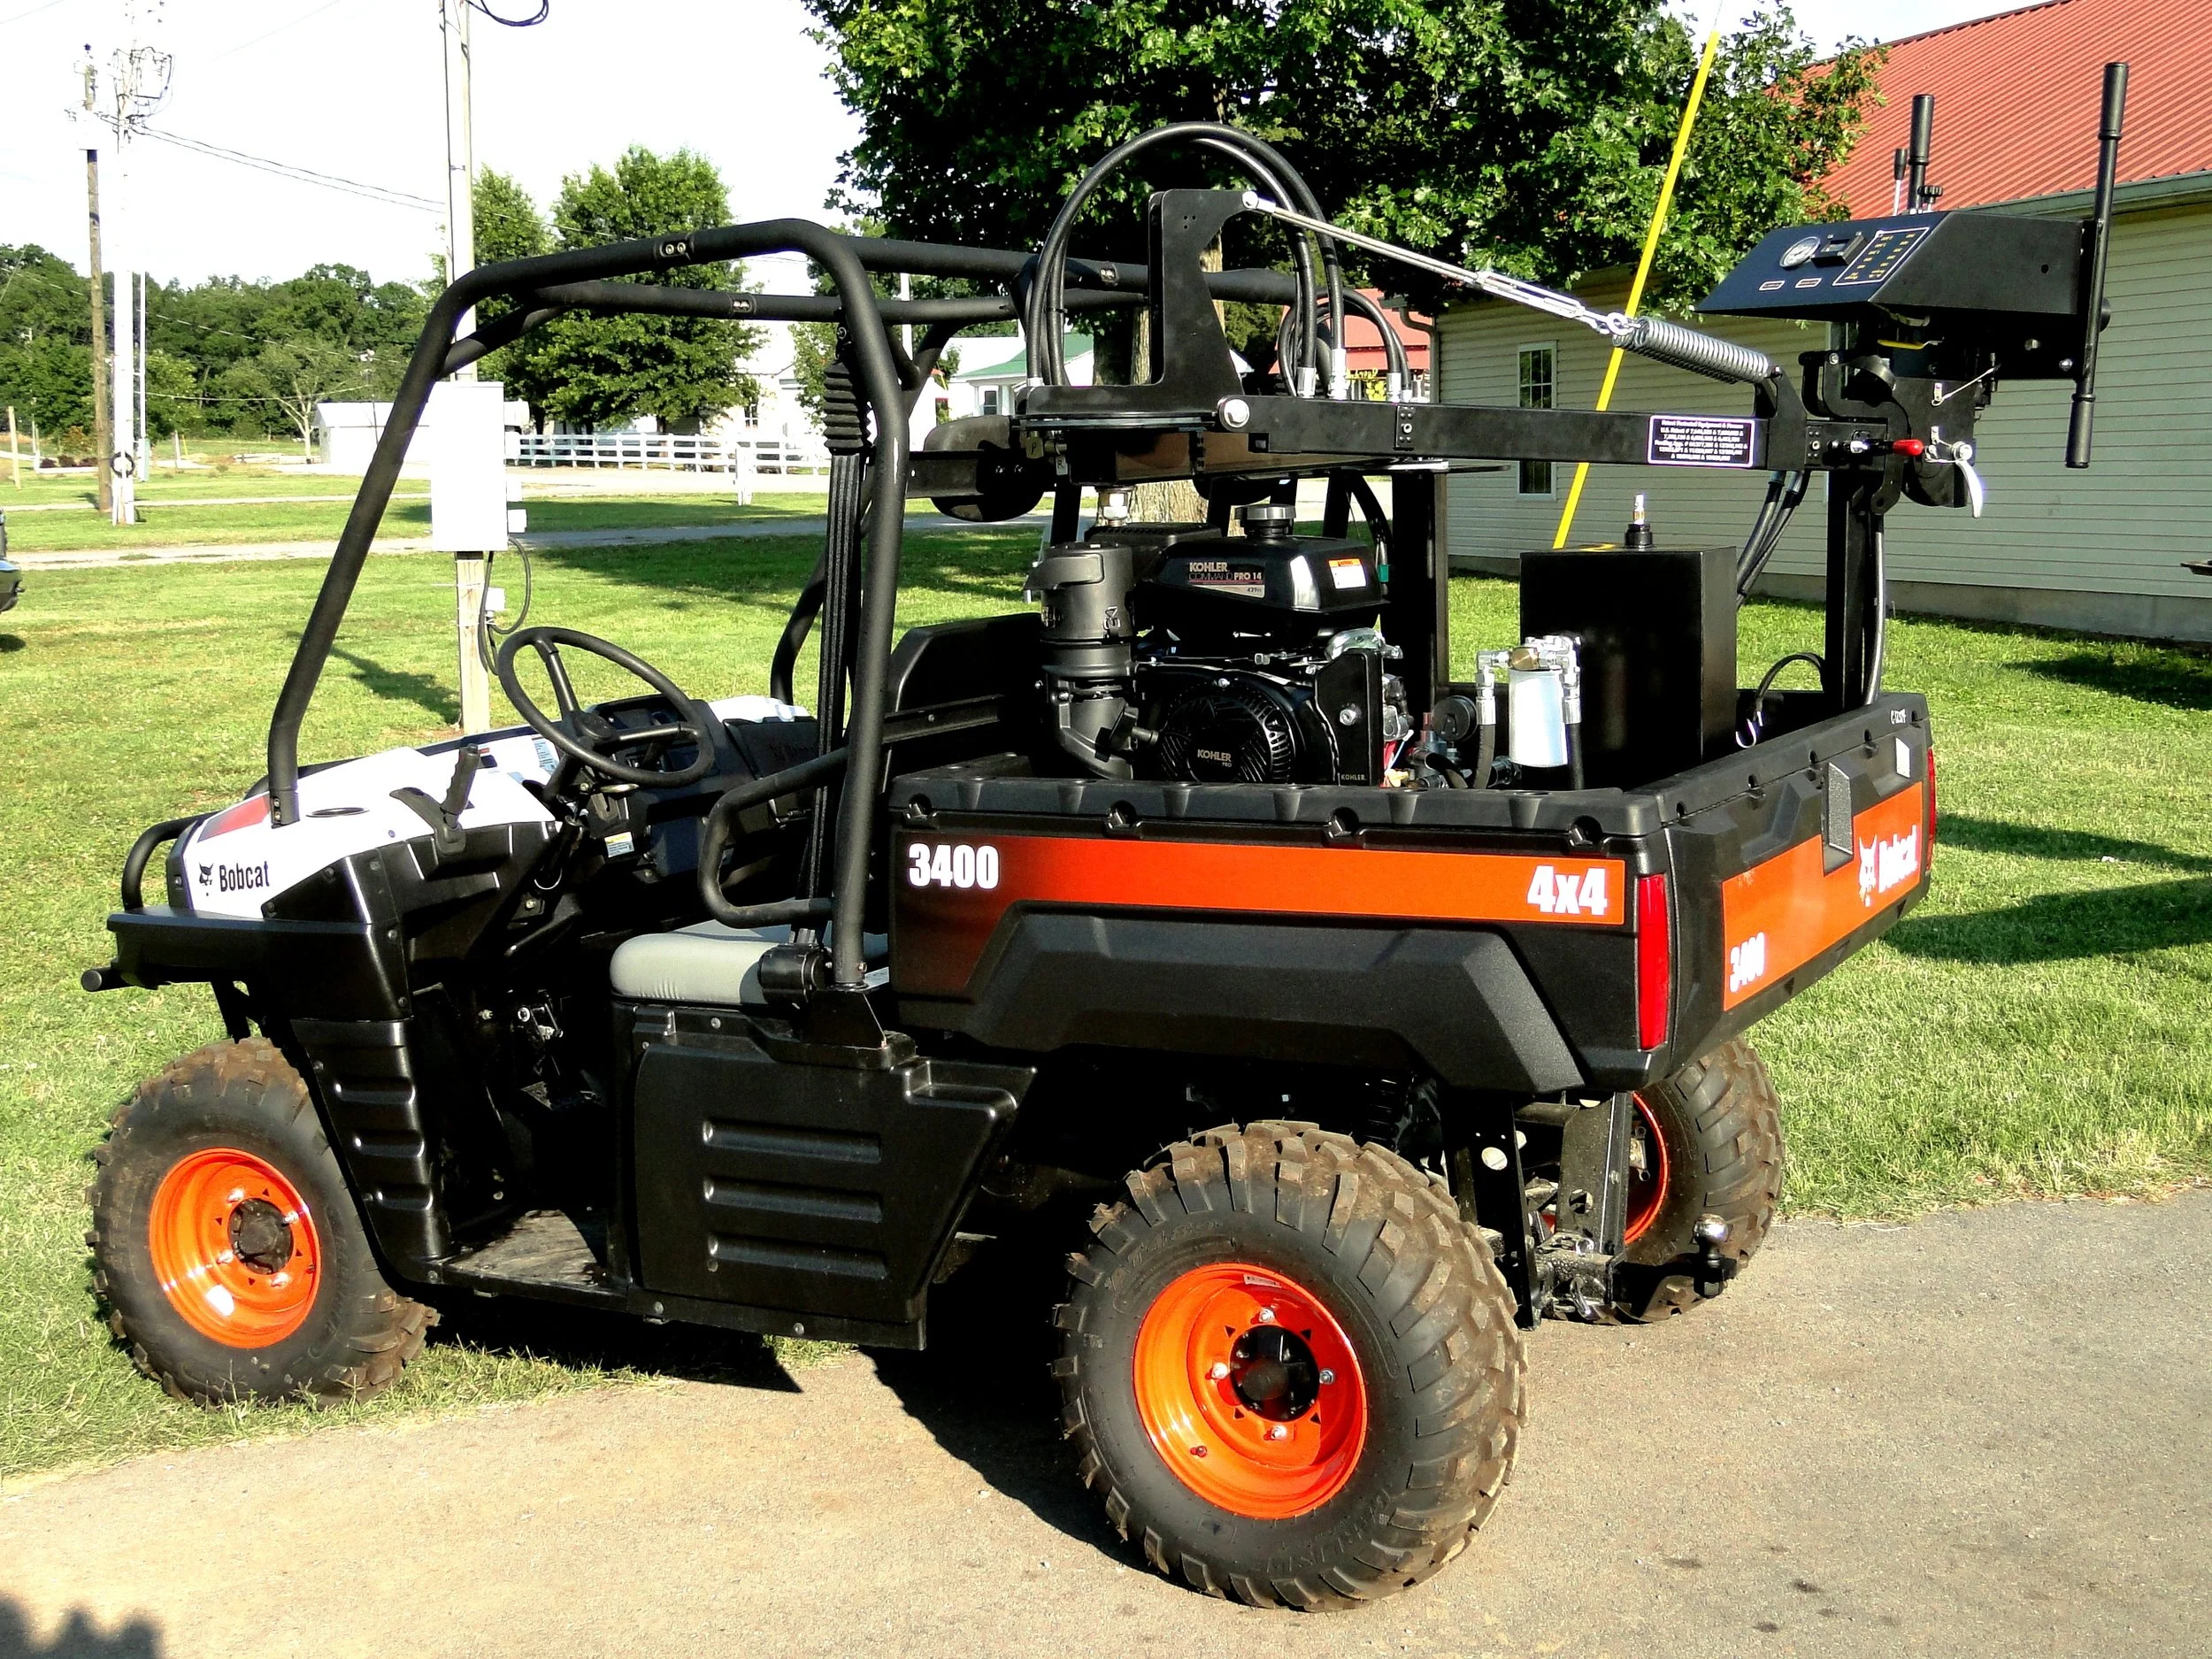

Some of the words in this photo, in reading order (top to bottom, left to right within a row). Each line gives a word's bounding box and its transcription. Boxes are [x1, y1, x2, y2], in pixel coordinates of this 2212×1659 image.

[1189, 562, 1228, 572] KOHLER
[1197, 749, 1232, 762] KOHLER
[219, 861, 269, 892] Bobcat
[908, 842, 1000, 889] 3400
[1526, 865, 1608, 916] 4x4
